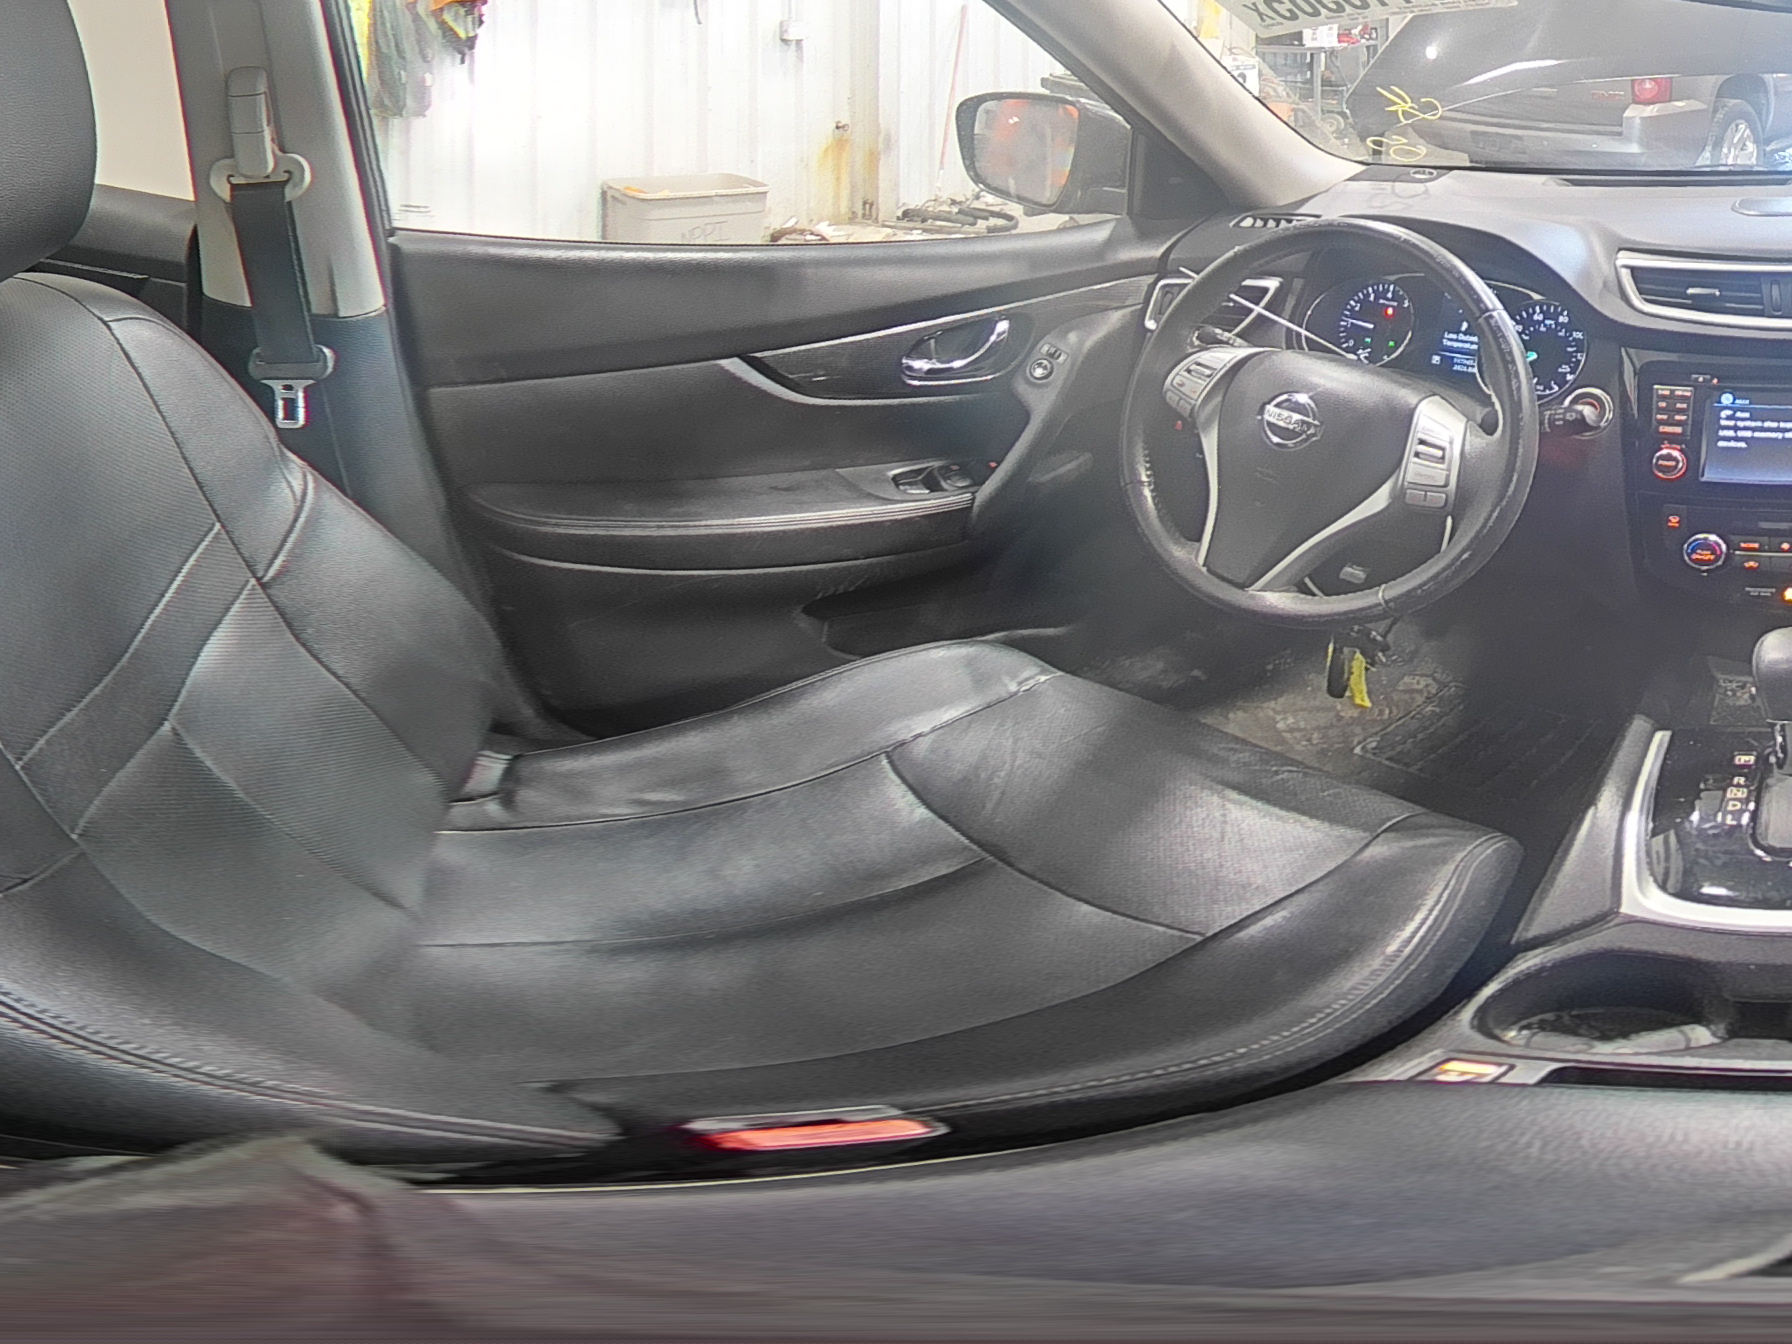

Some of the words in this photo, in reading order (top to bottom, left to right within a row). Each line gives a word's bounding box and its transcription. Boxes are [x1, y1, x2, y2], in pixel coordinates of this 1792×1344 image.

[1266, 408, 1309, 432] NISSAN
[1733, 776, 1747, 786] R
[1727, 800, 1742, 811] D
[1726, 813, 1738, 825] L
